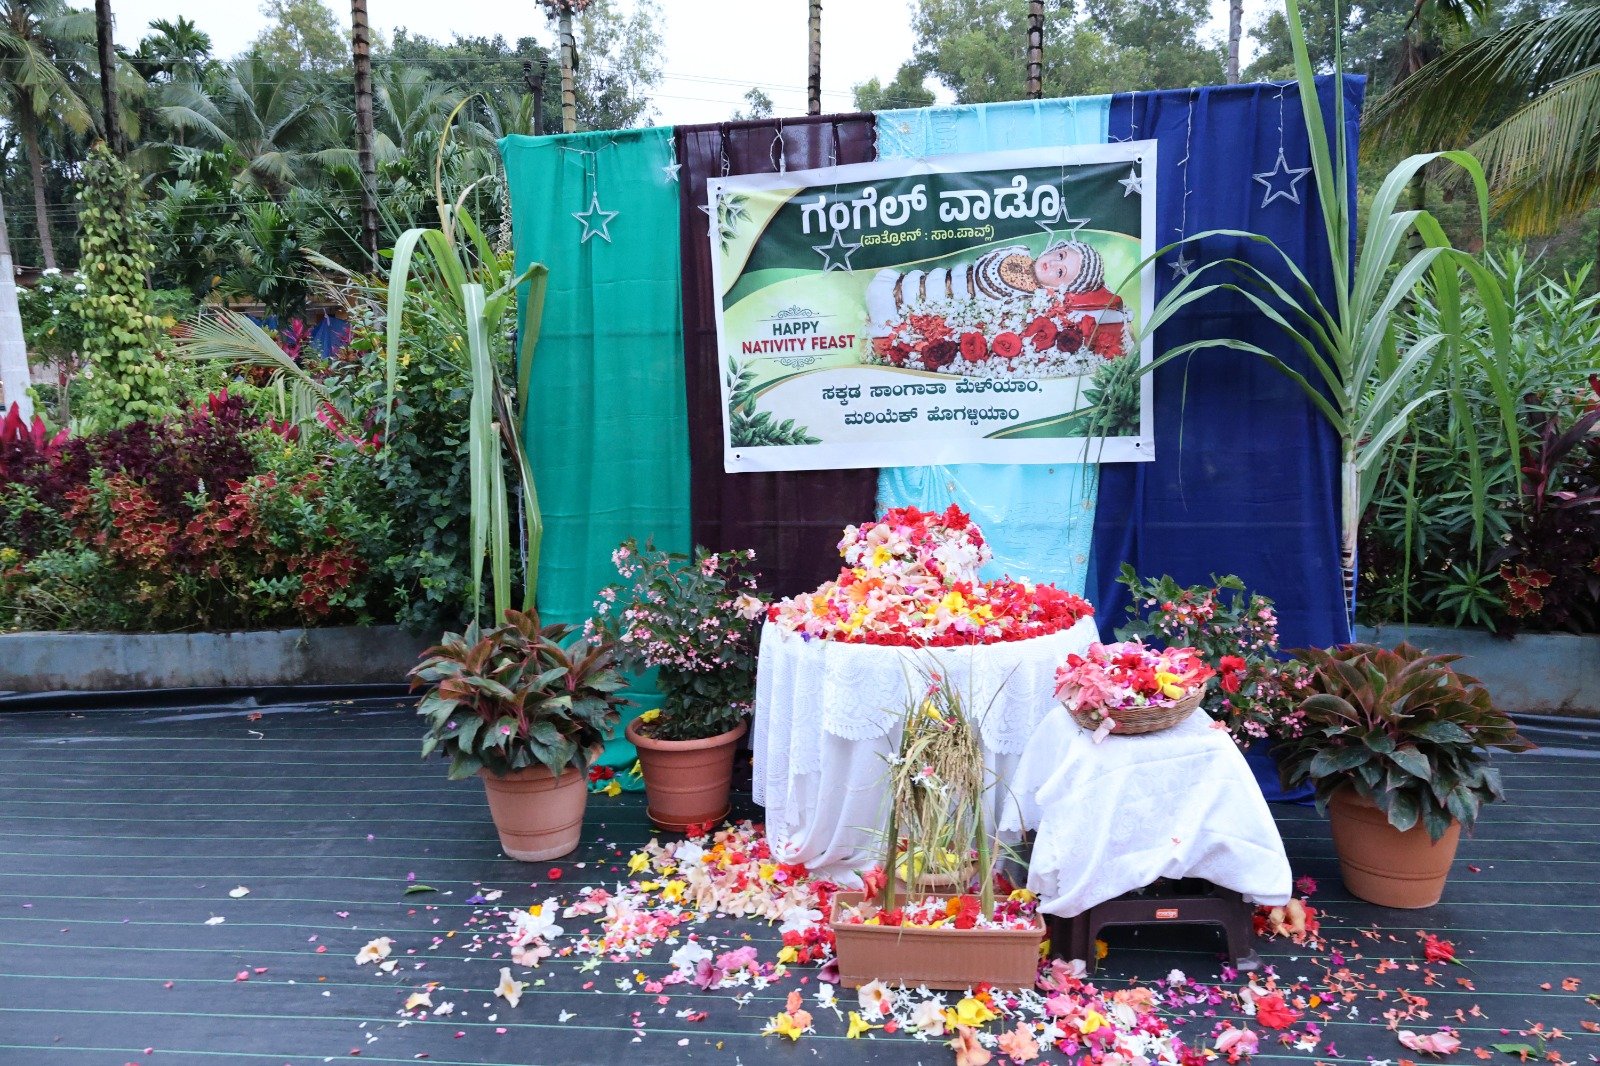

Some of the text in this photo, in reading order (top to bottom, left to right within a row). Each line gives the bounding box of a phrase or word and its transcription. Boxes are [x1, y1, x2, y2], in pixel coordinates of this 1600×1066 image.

[800, 184, 928, 234] ಗಂಗೆಲ್
[772, 321, 820, 336] HAPPY
[742, 335, 855, 354] NATIVITY FEAST
[822, 384, 861, 406] ಸಕ್ಕಡ
[870, 382, 947, 398] ಸಾಂಗಾತಾ
[844, 407, 918, 425] ಮರಿಯೆಕ್
